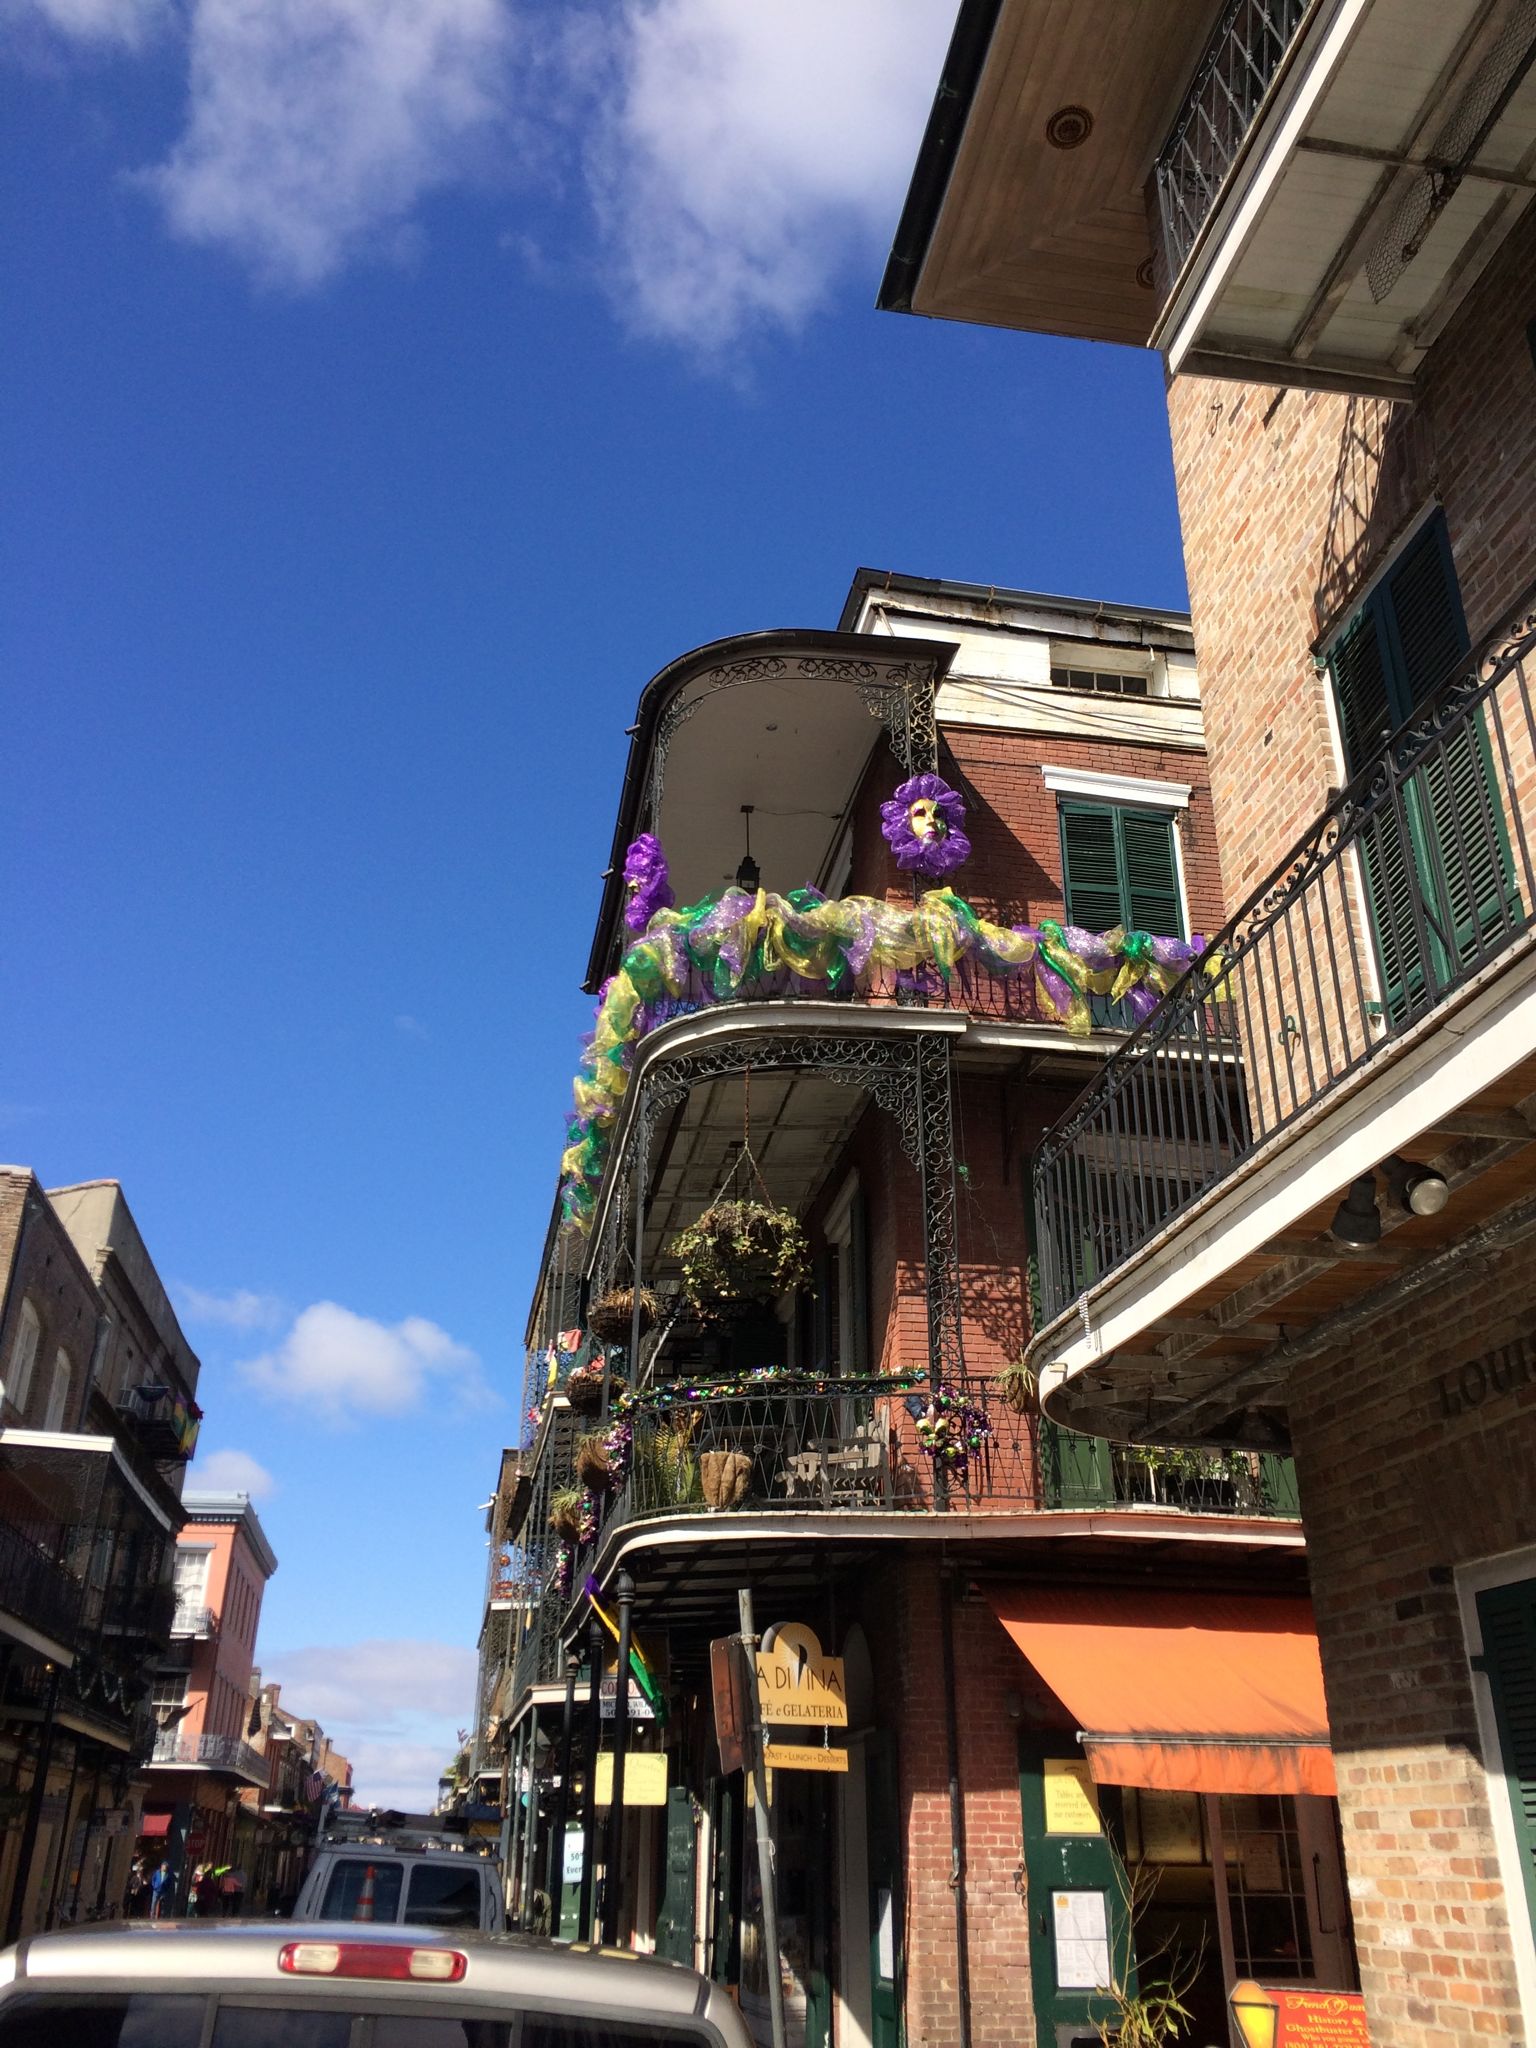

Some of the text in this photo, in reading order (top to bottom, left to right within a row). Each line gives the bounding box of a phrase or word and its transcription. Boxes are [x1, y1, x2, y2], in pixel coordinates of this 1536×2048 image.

[756, 1666, 770, 1689] A
[776, 1708, 782, 1717] e
[783, 1703, 844, 1719] GELATERIA
[788, 1752, 812, 1762] LUNCH
[1307, 2014, 1363, 2027] History &
[1285, 2023, 1354, 2036] Ghostbuster
